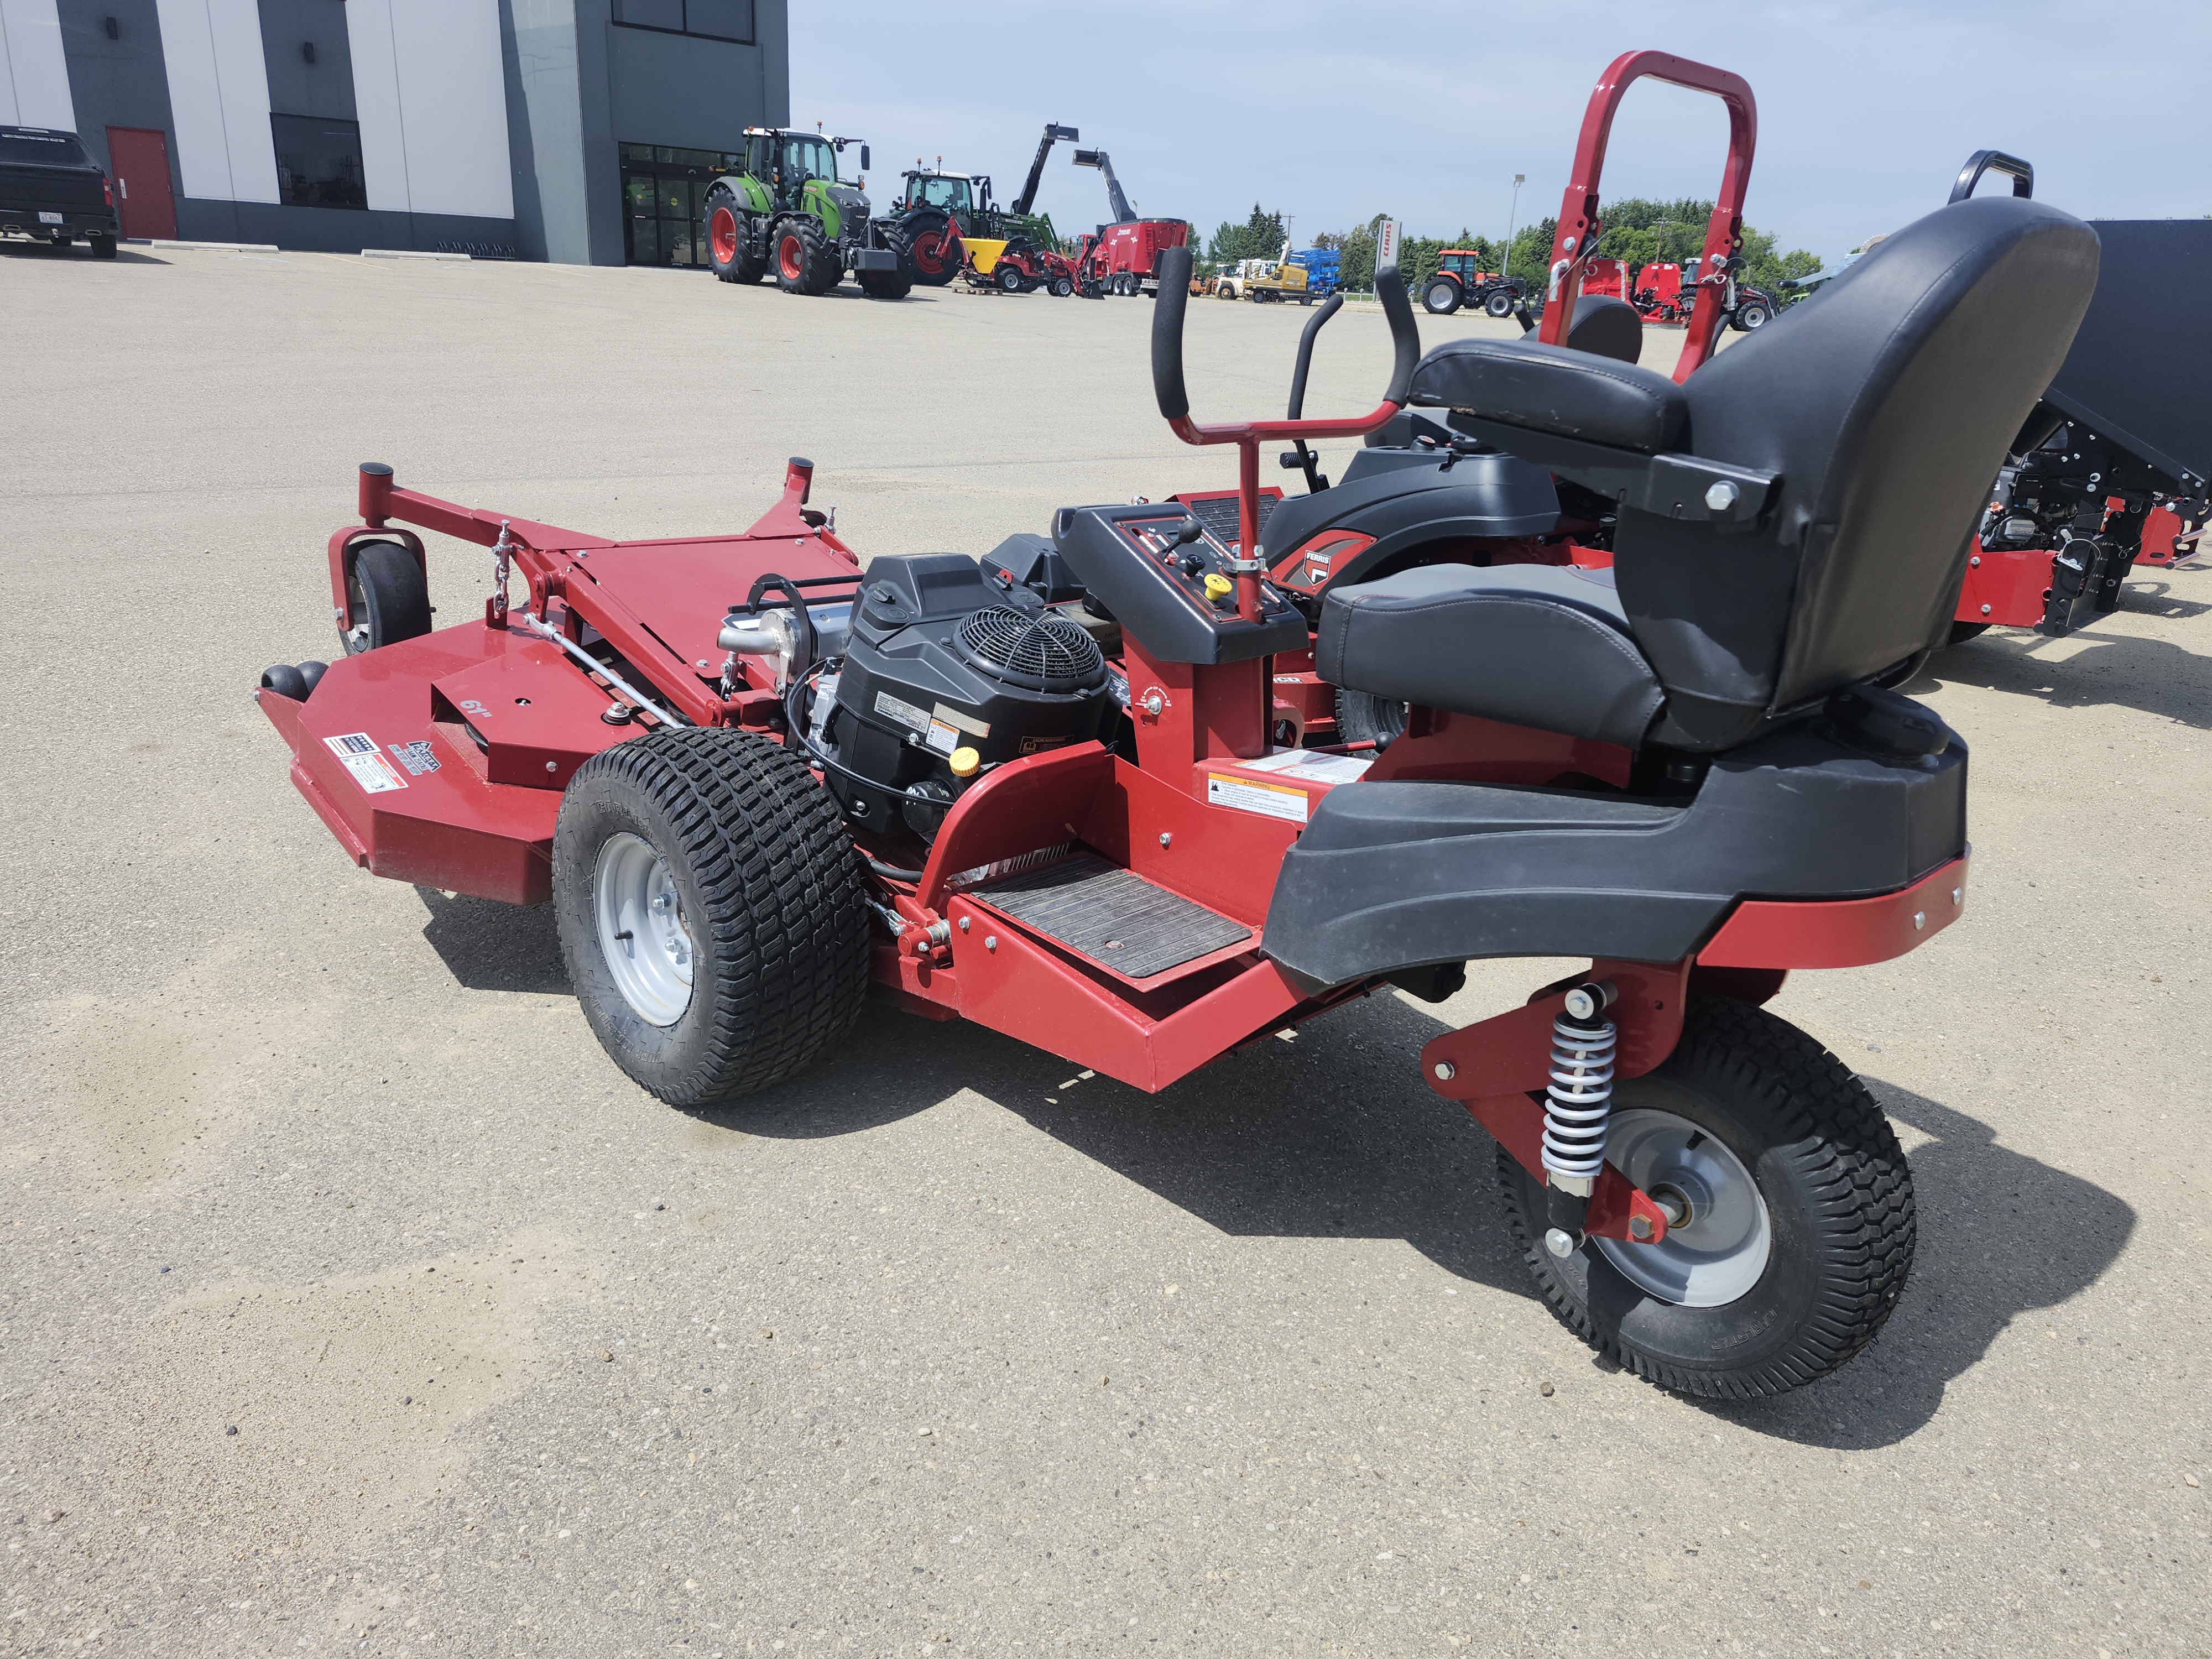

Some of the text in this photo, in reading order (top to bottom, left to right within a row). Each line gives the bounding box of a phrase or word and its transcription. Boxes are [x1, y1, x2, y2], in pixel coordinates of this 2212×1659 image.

[1306, 552, 1329, 564] FERRIS
[460, 700, 493, 718] 61"
[408, 741, 440, 771] Pentagon
[1248, 780, 1270, 790] WARNING
[635, 1050, 662, 1064] TURF
